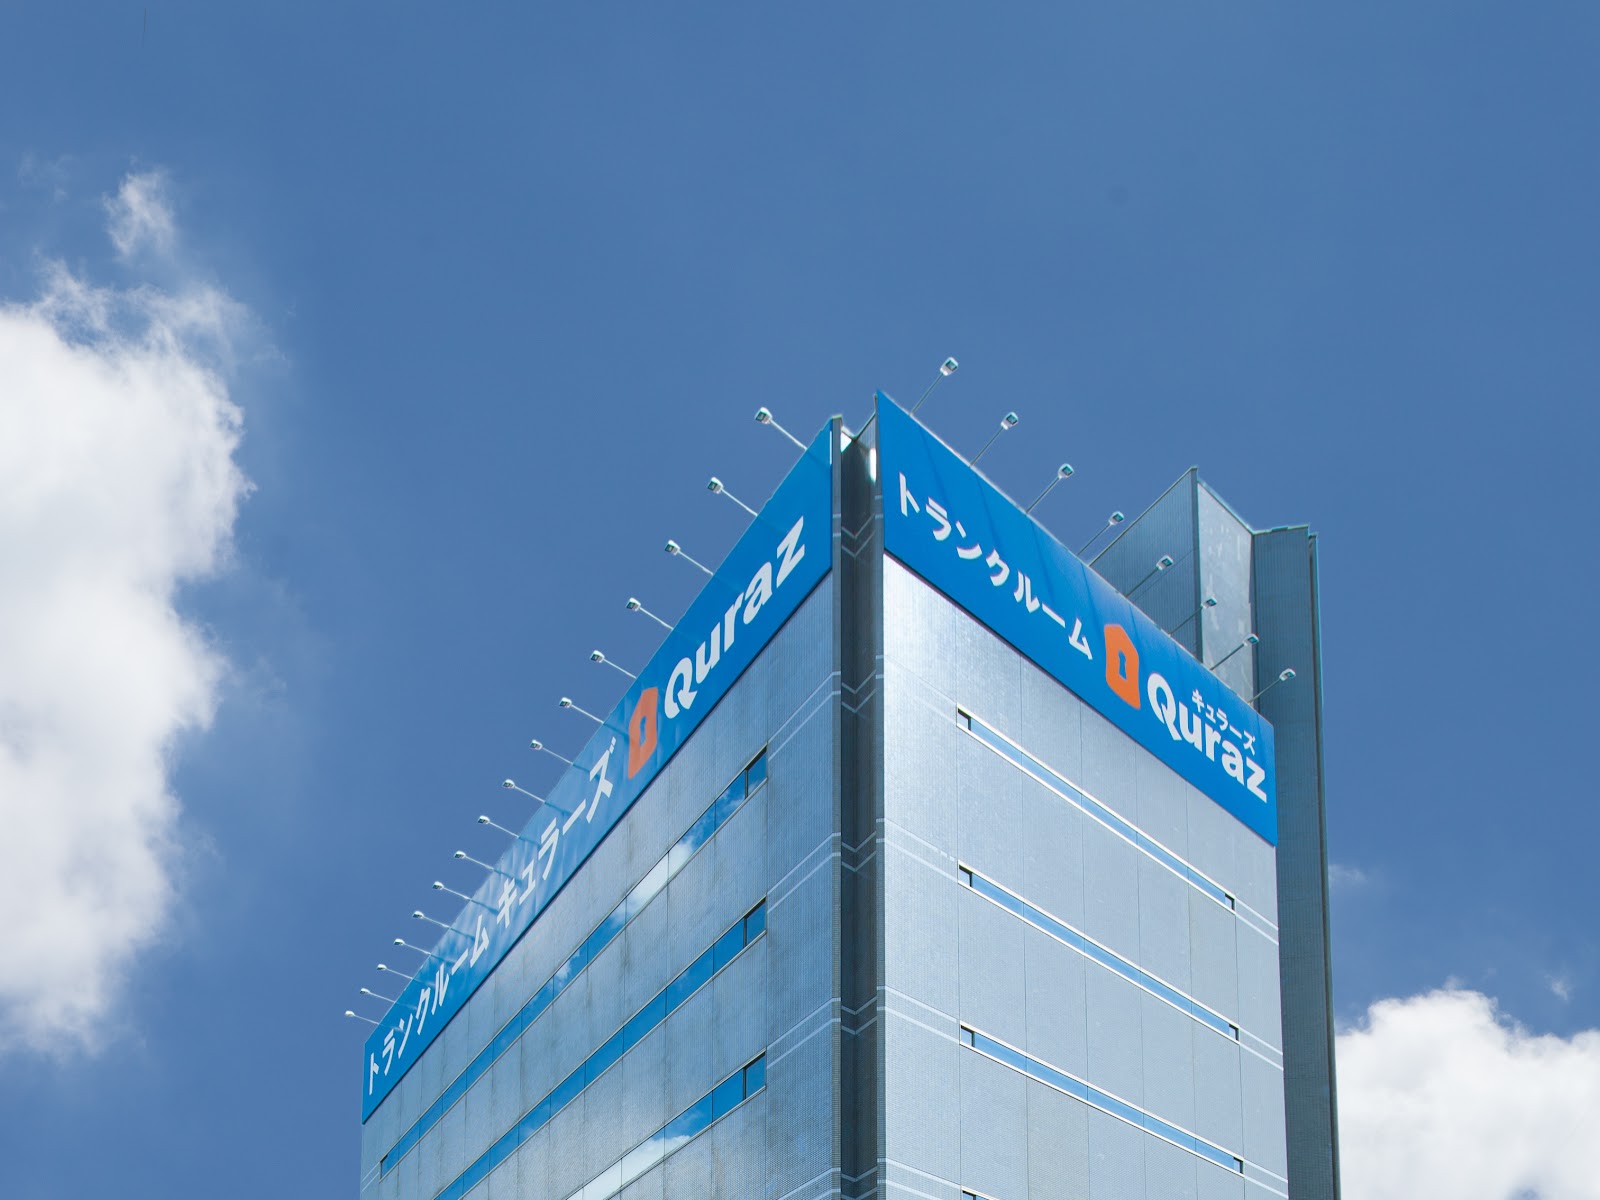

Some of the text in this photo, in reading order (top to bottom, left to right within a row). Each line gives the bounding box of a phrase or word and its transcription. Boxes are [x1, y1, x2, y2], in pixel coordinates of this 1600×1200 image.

[664, 516, 805, 719] Quraz
[899, 471, 1092, 661] トランクルーム
[1146, 671, 1268, 804] Quraz
[1191, 689, 1257, 753] キュラーズ
[367, 738, 618, 1095] トランクルーム キュラーズ
